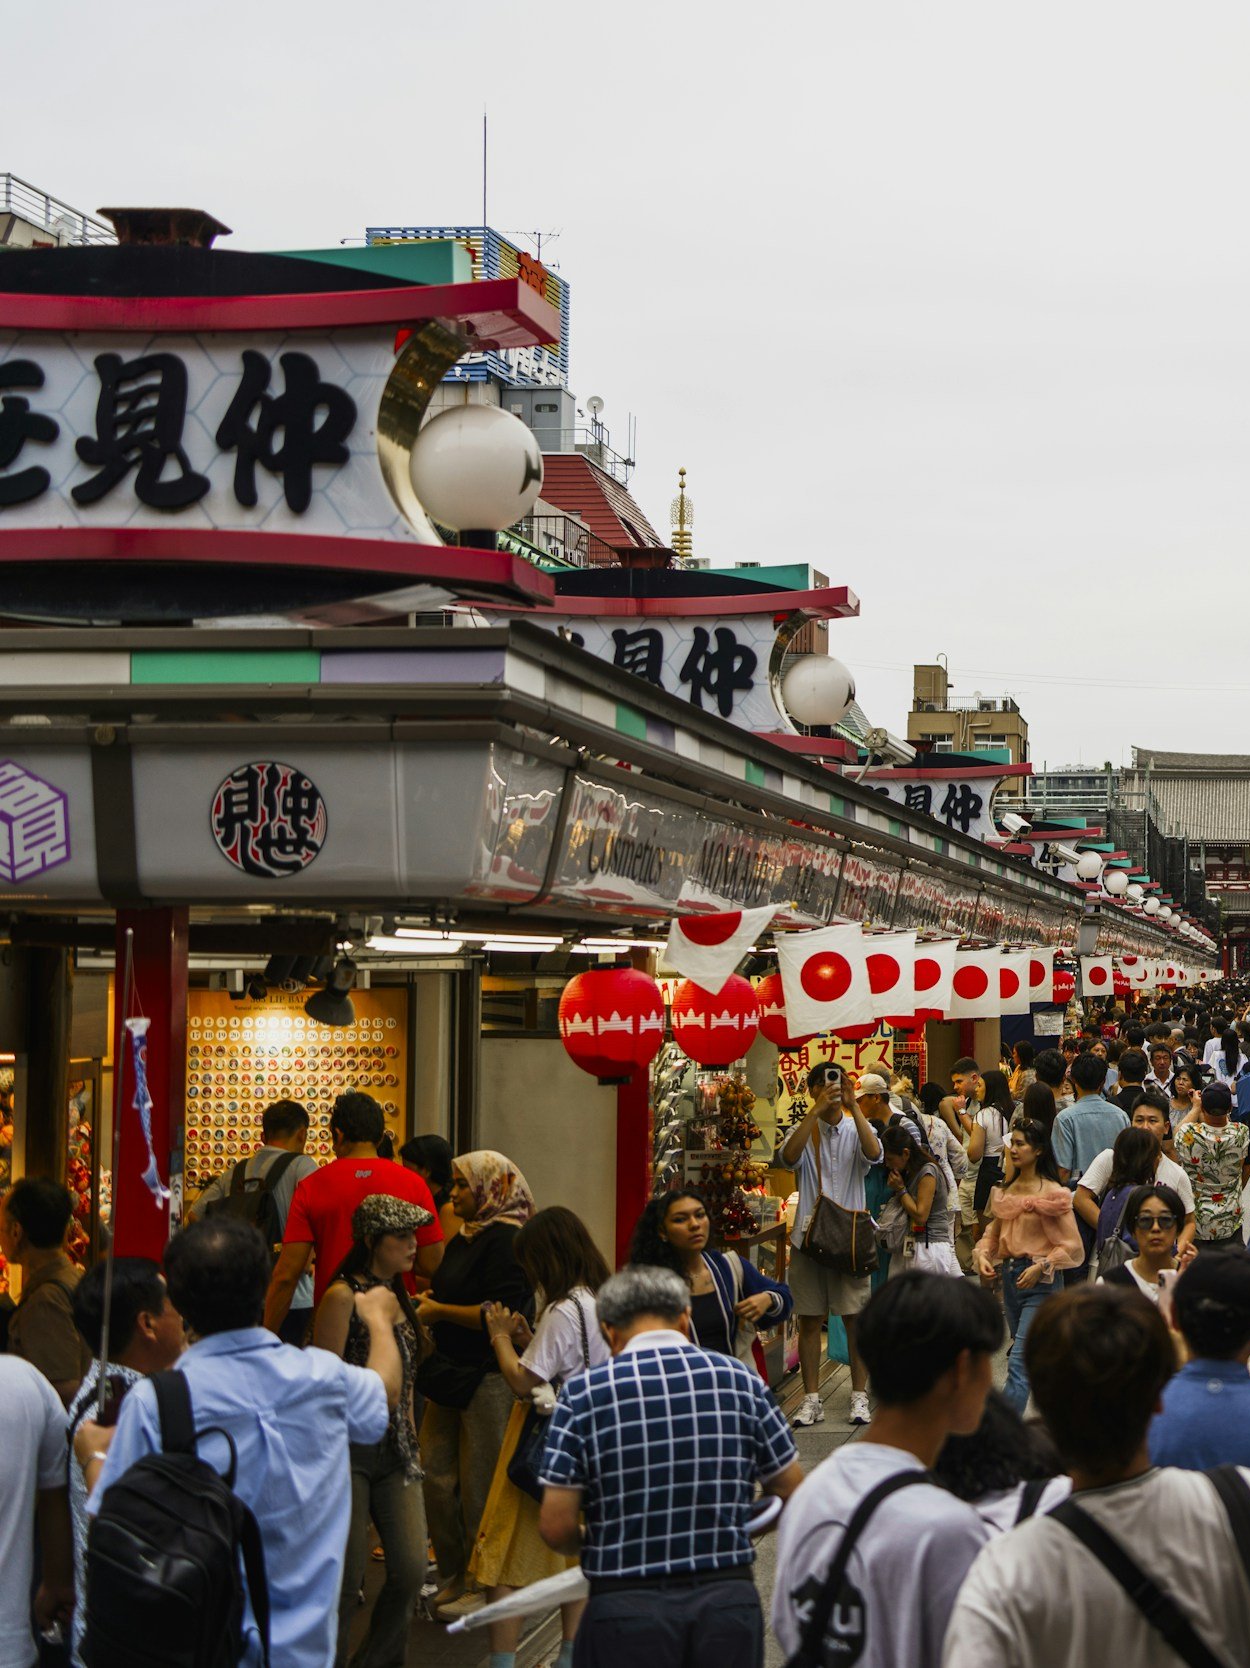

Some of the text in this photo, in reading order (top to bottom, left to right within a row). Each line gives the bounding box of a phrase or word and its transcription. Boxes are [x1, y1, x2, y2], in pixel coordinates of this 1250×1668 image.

[270, 996, 285, 1004] LIP
[818, 1040, 892, 1070] サービス
